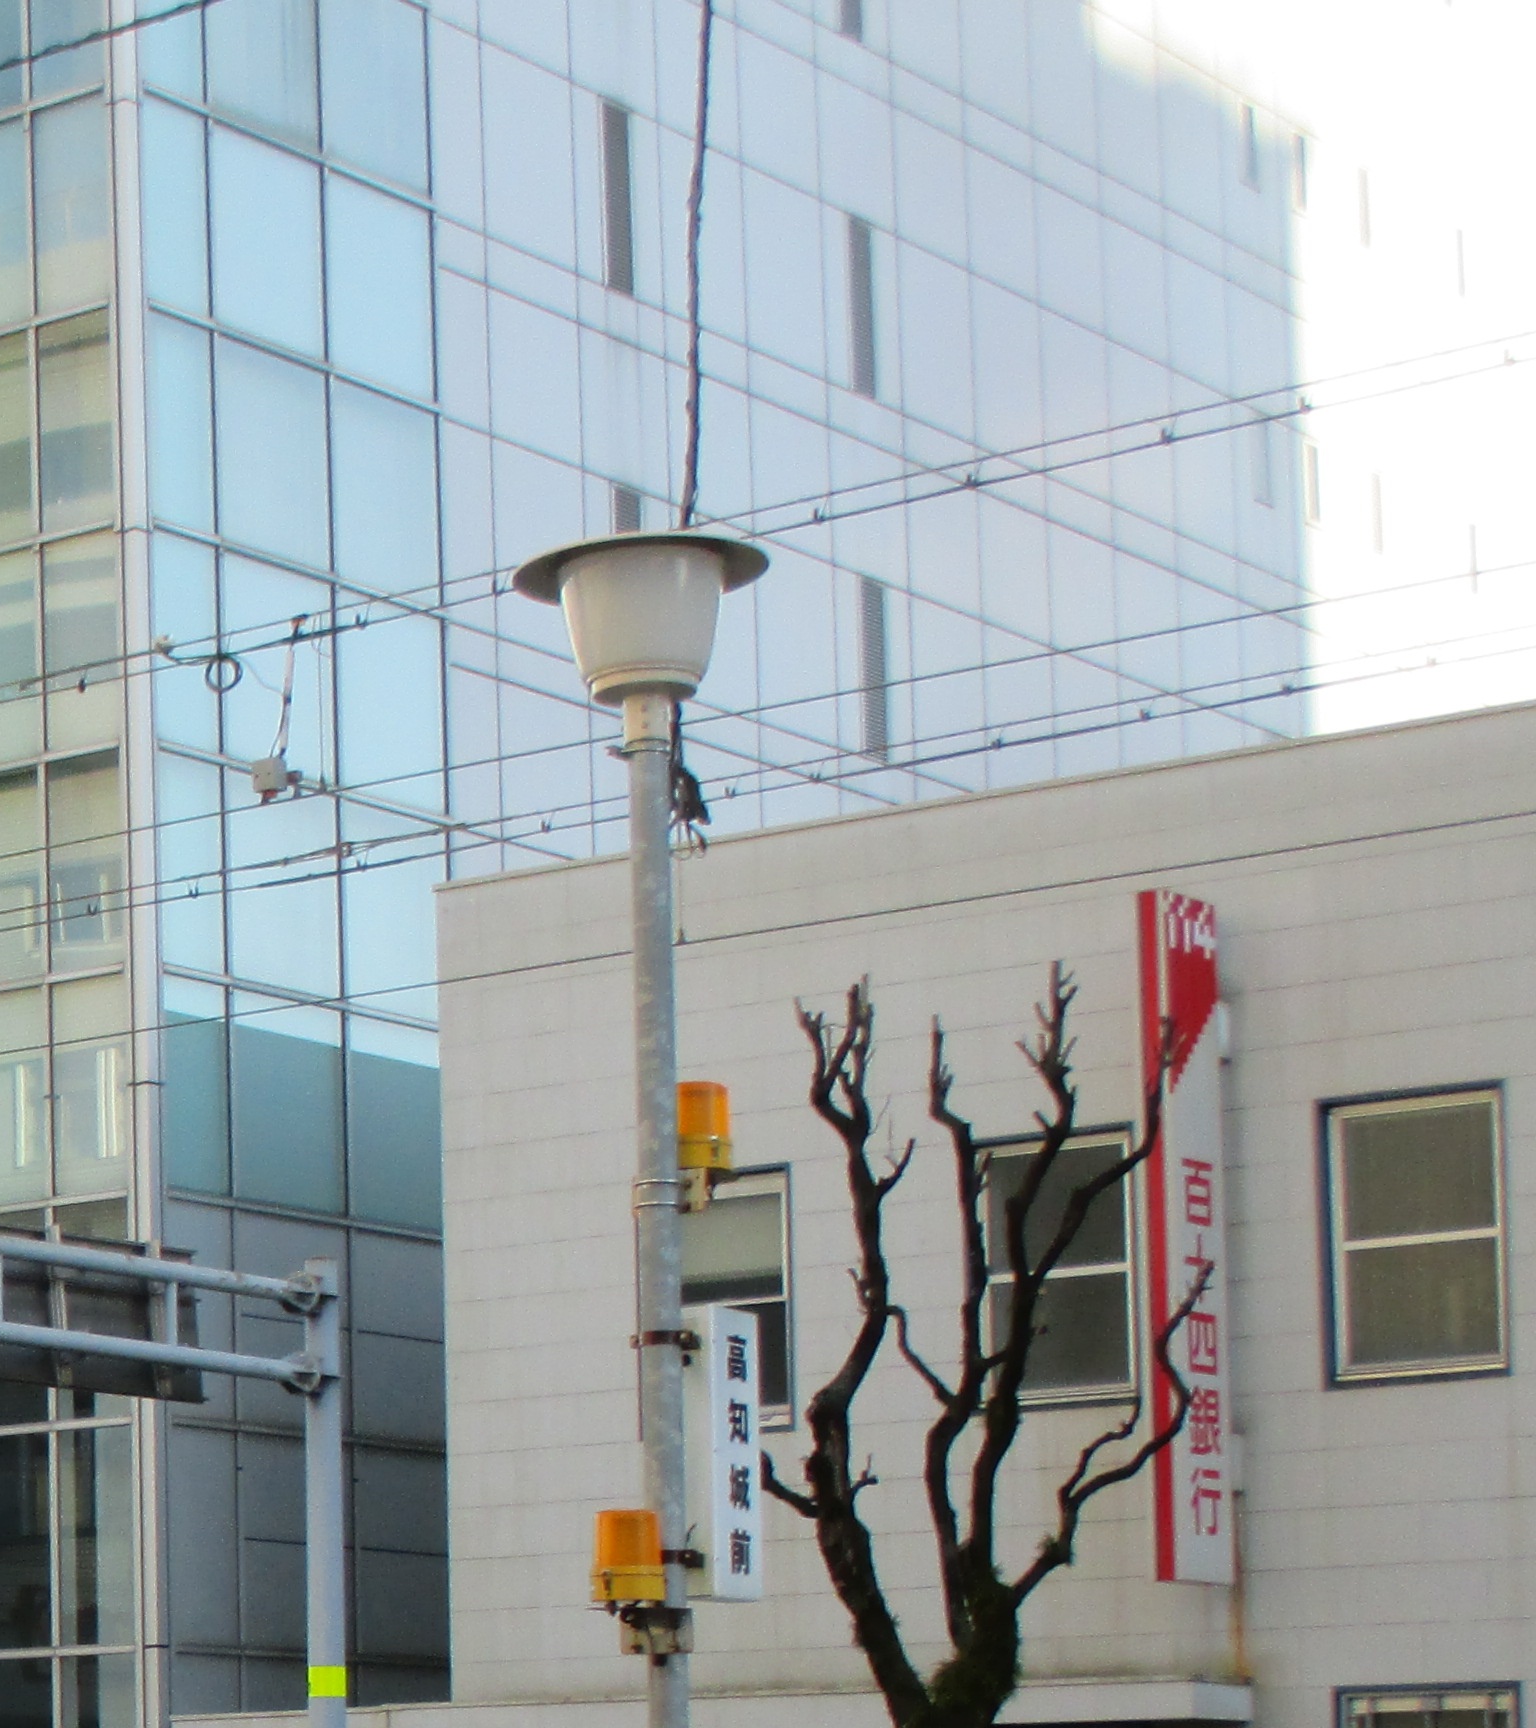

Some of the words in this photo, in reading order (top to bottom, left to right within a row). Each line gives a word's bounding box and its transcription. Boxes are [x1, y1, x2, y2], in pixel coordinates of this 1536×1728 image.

[725, 1333, 751, 1576] 高知城前
[1180, 1157, 1224, 1537] 百十四銀行
